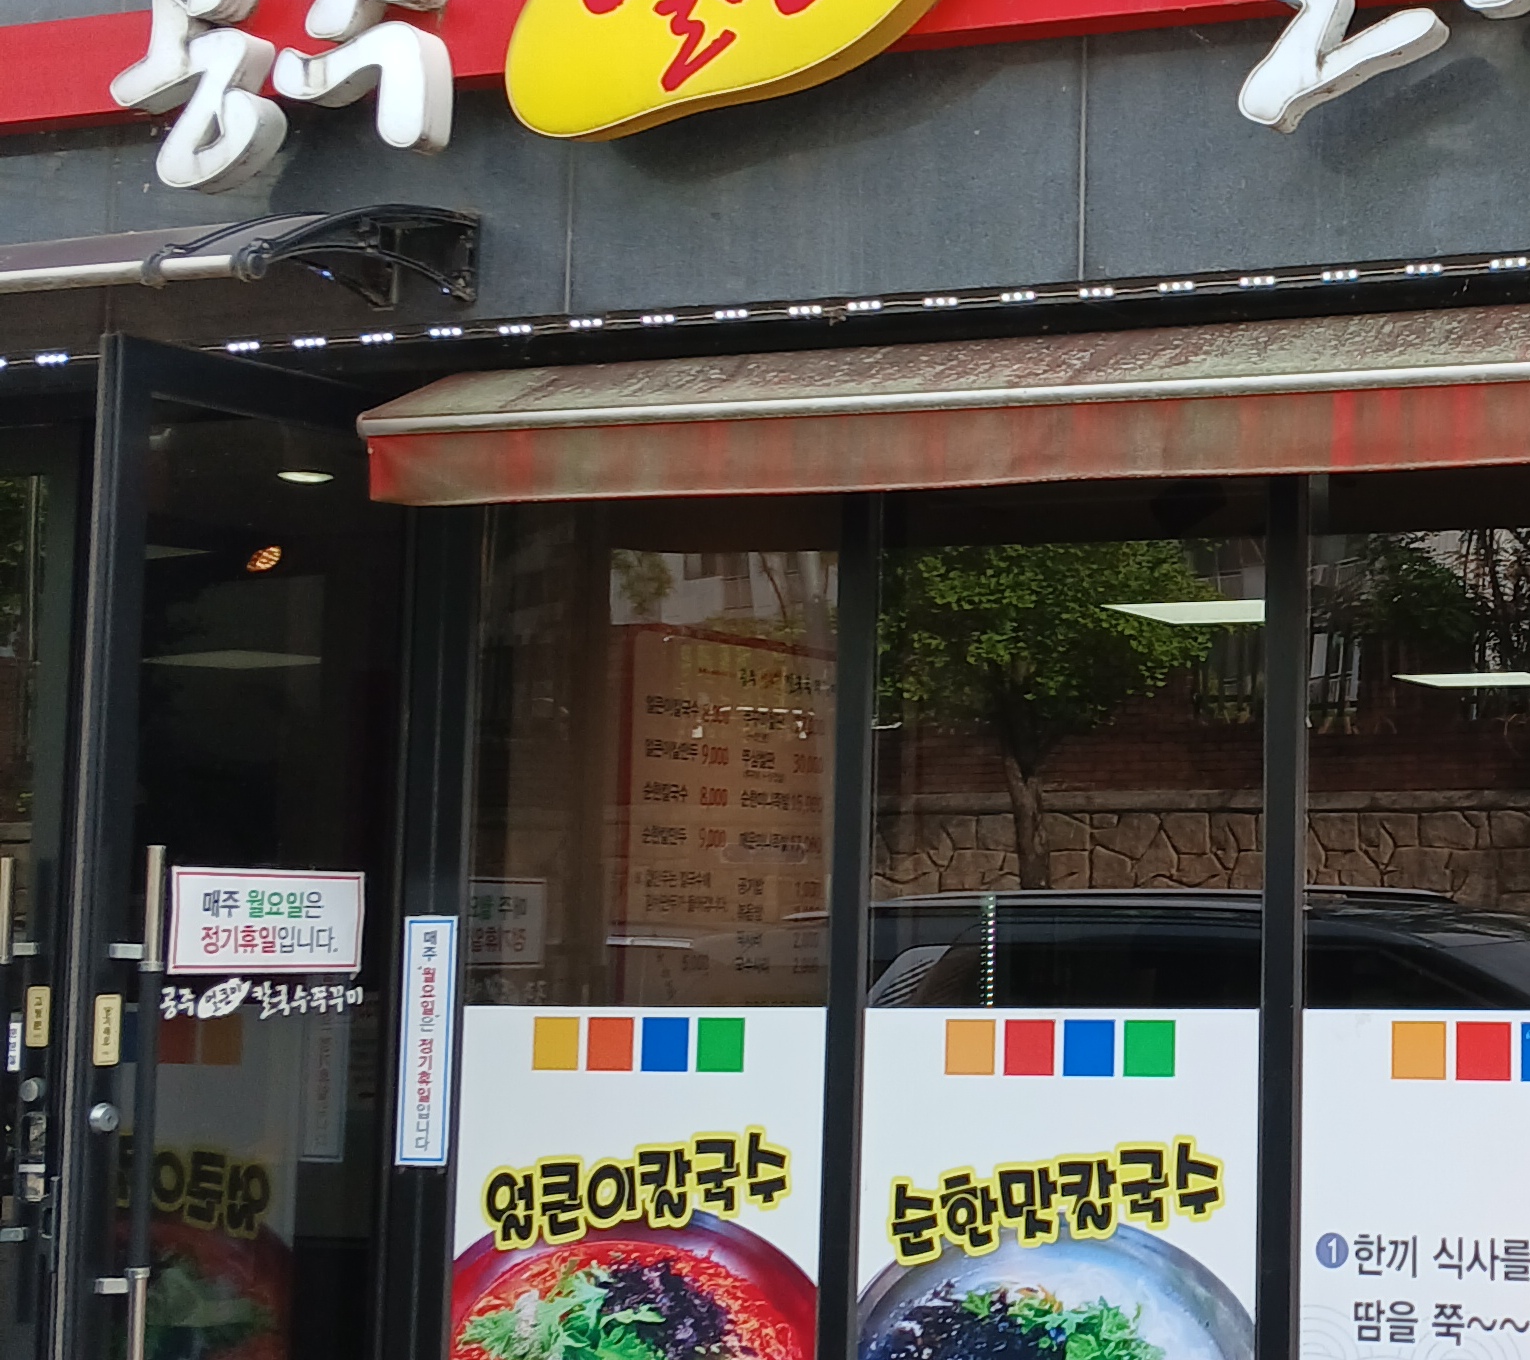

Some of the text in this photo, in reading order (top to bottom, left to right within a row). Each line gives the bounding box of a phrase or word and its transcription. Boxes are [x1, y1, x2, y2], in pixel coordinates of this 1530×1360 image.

[701, 743, 730, 765] 9,000
[700, 786, 729, 806] 8,000
[202, 889, 325, 919] 매주 월요일은
[201, 925, 339, 955] 정기휴일입니다.
[421, 930, 438, 963] 매주
[160, 986, 198, 1020] 공주
[251, 980, 309, 1020] 칼국수
[485, 1128, 790, 1243] 얼큰이칼국수
[890, 1135, 1223, 1261] 순한맛칼국수
[1354, 1233, 1418, 1278] 한끼
[1353, 1300, 1418, 1344] 땀을
